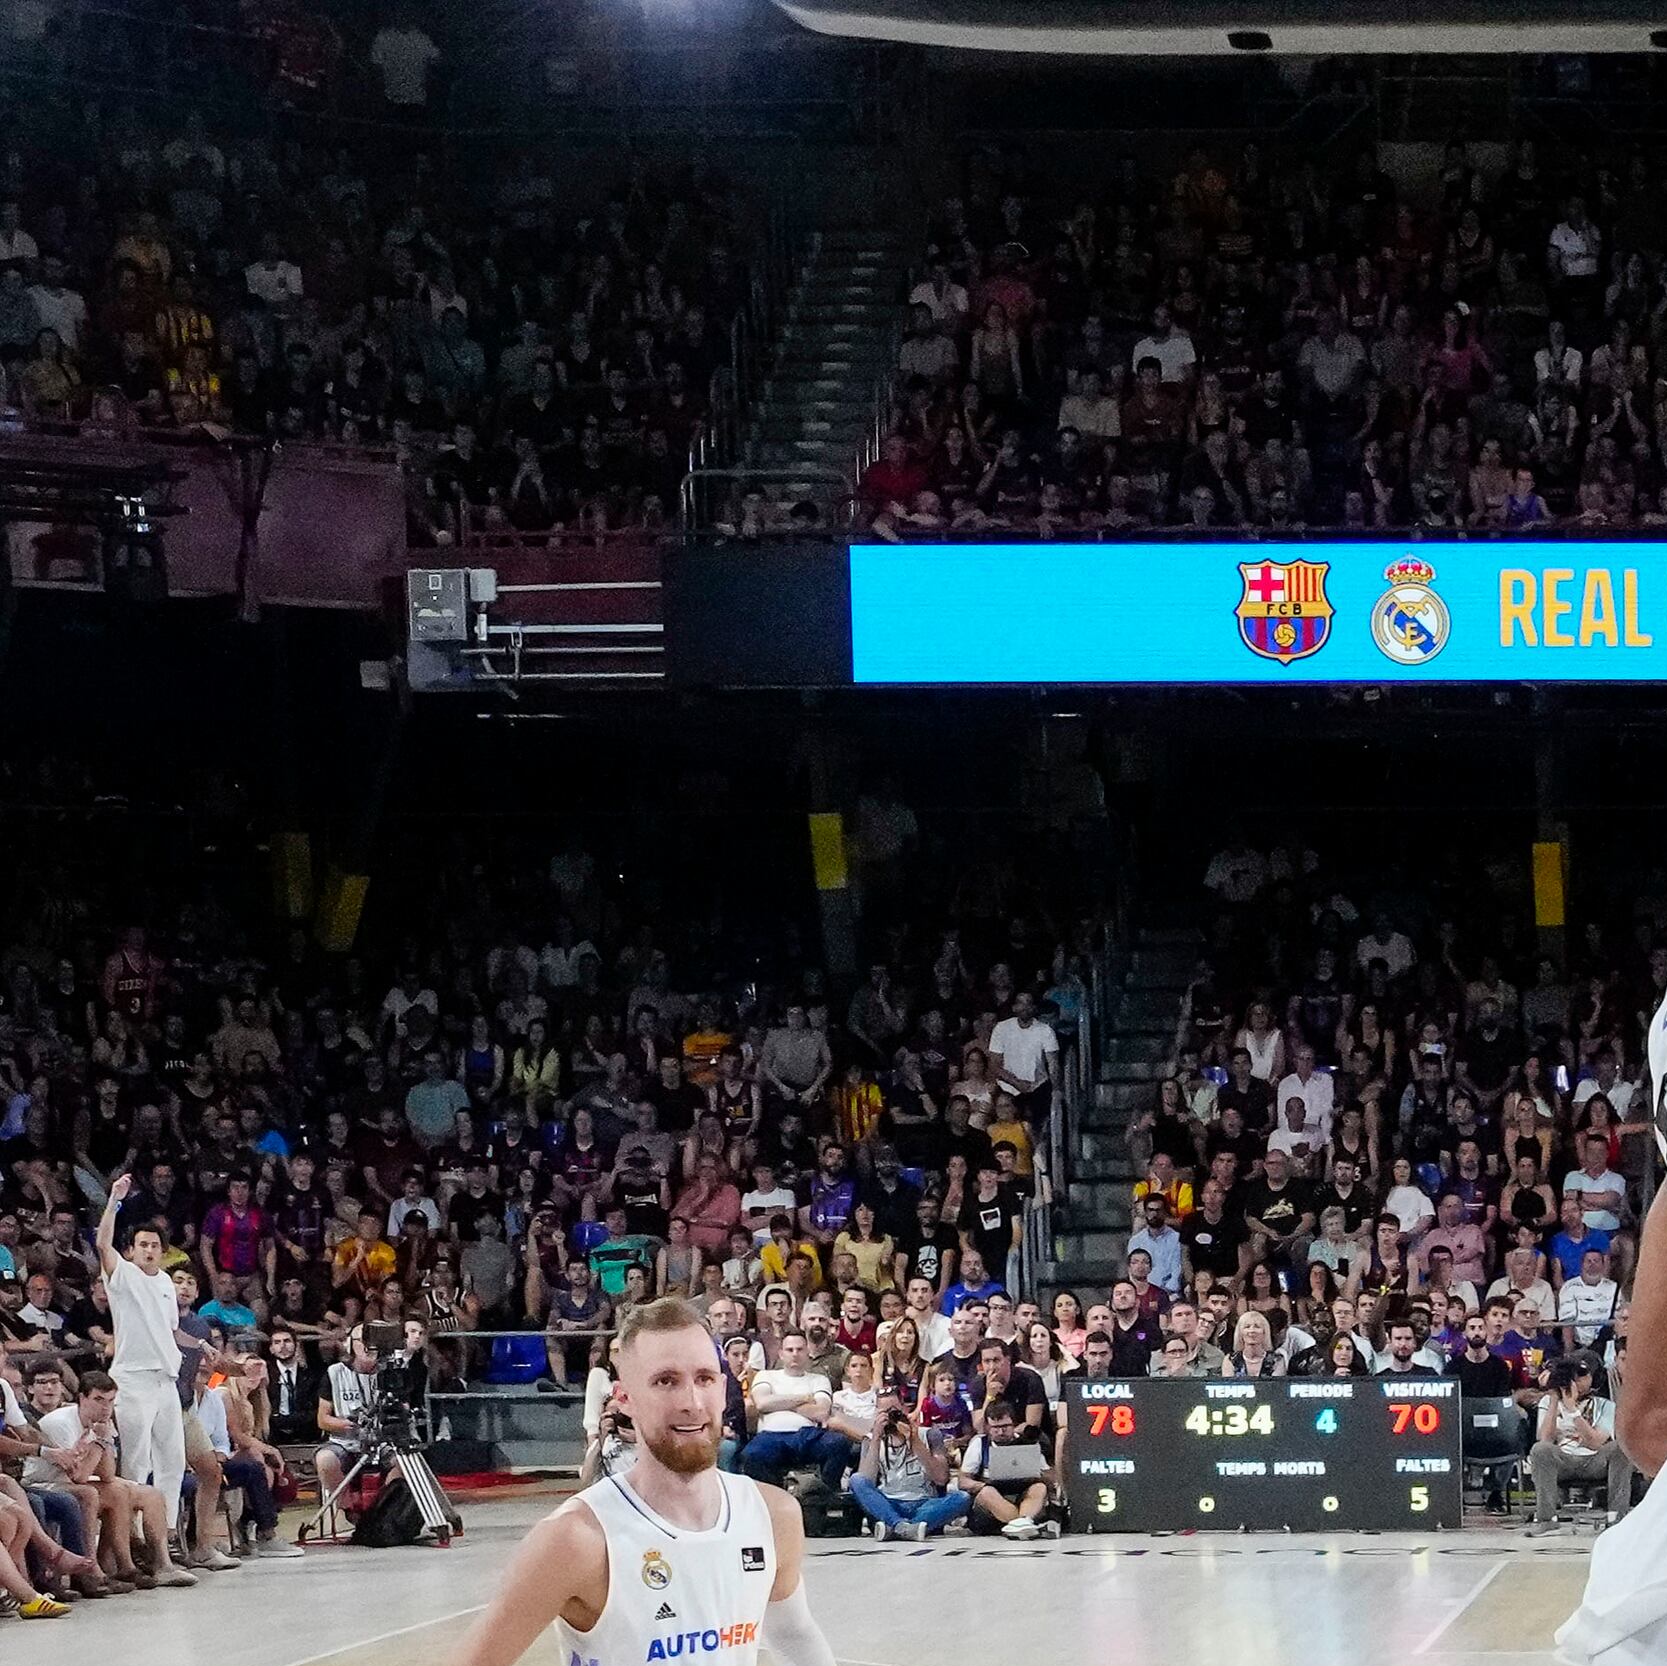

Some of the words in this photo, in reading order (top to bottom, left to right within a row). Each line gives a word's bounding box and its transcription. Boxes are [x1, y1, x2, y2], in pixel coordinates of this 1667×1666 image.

[1500, 567, 1652, 648] REAL
[1081, 1384, 1134, 1399] LOCAL
[1206, 1384, 1256, 1398] TEMPS
[1290, 1384, 1353, 1398] PERIODE
[1383, 1383, 1455, 1398] VISITANT
[1087, 1405, 1135, 1436] 78
[1185, 1405, 1274, 1436] 4:34
[1316, 1408, 1337, 1434] 4
[1389, 1404, 1439, 1434] 70
[1080, 1460, 1135, 1474] FALTES
[1216, 1461, 1266, 1475] TEMPS
[1274, 1461, 1326, 1475] MORTS
[1396, 1458, 1450, 1473] FALTES
[1097, 1488, 1117, 1512] 3
[1409, 1487, 1429, 1511] 5
